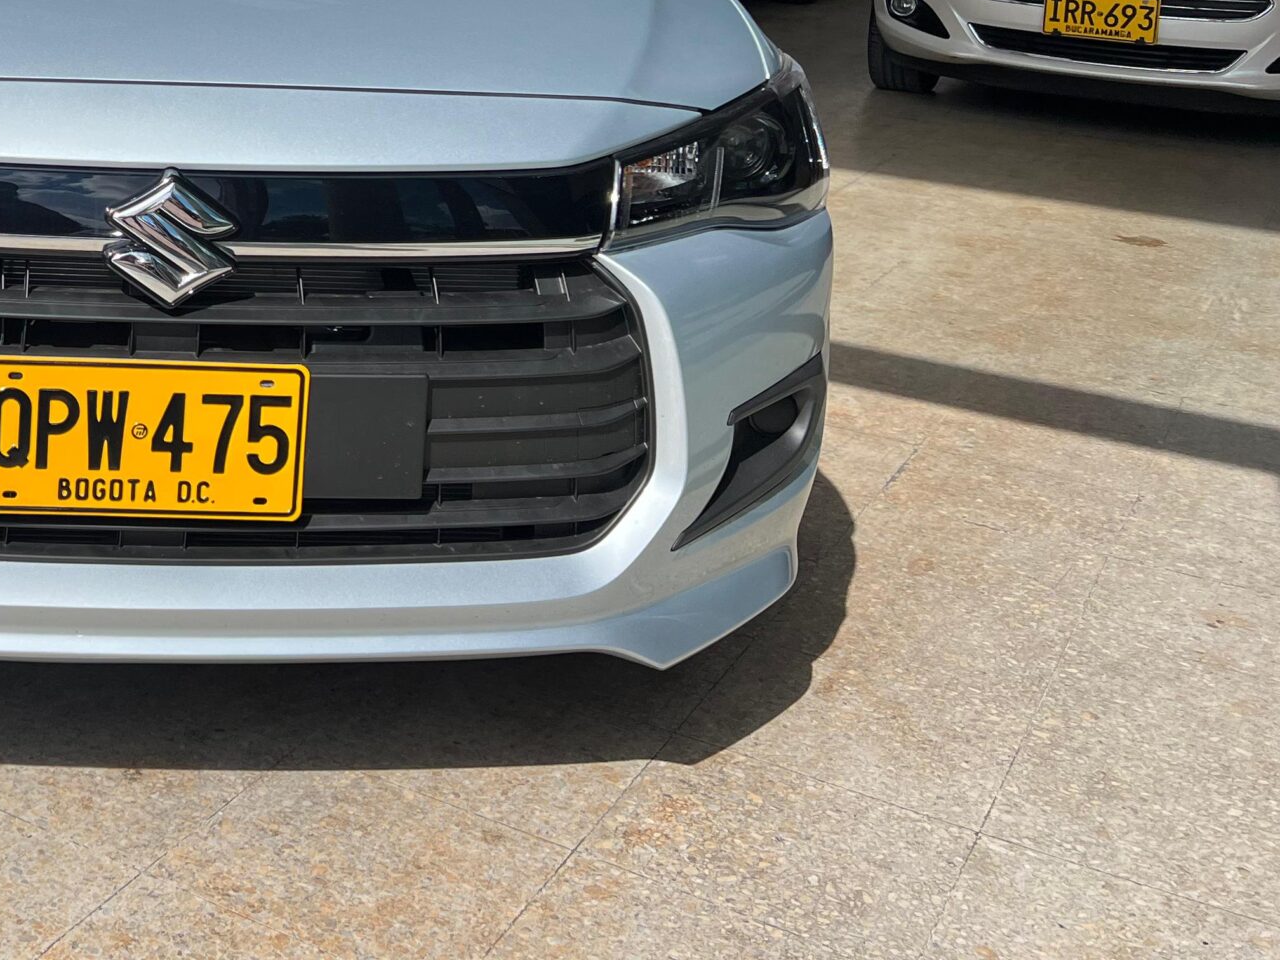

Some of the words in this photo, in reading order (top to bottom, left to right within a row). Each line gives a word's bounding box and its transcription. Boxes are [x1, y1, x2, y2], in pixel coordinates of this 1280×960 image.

[1065, 24, 1132, 38] BUCARAMANGA
[151, 393, 292, 475] 475
[57, 478, 157, 502] BOGOTA
[177, 481, 216, 504] D.C.
